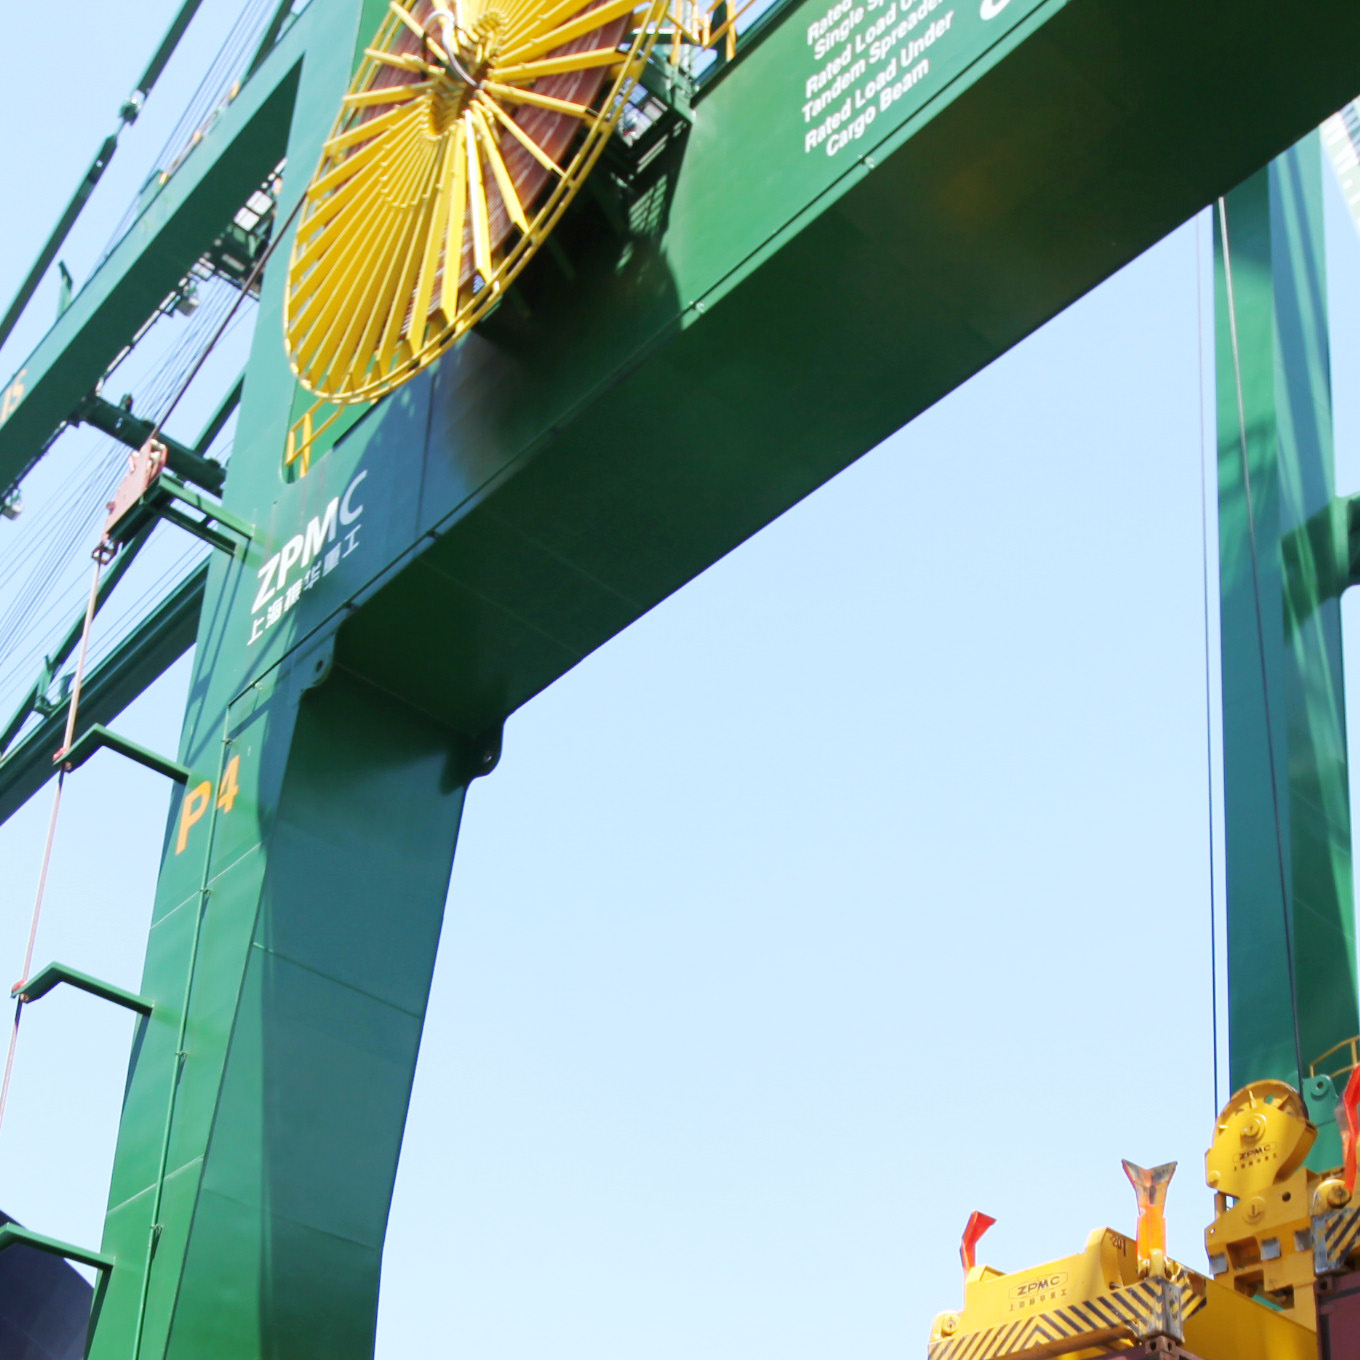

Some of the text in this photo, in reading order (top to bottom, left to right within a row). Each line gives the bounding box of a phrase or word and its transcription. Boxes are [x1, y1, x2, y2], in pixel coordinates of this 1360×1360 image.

[802, 0, 941, 123] Tandem Spreade
[805, 10, 954, 153] Rated Load Under
[806, 2, 897, 99] Rated Load
[814, 7, 865, 60] Single
[826, 58, 930, 157] Cargo Beam
[251, 469, 368, 615] ZPMC
[1018, 1276, 1060, 1296] ZPMC
